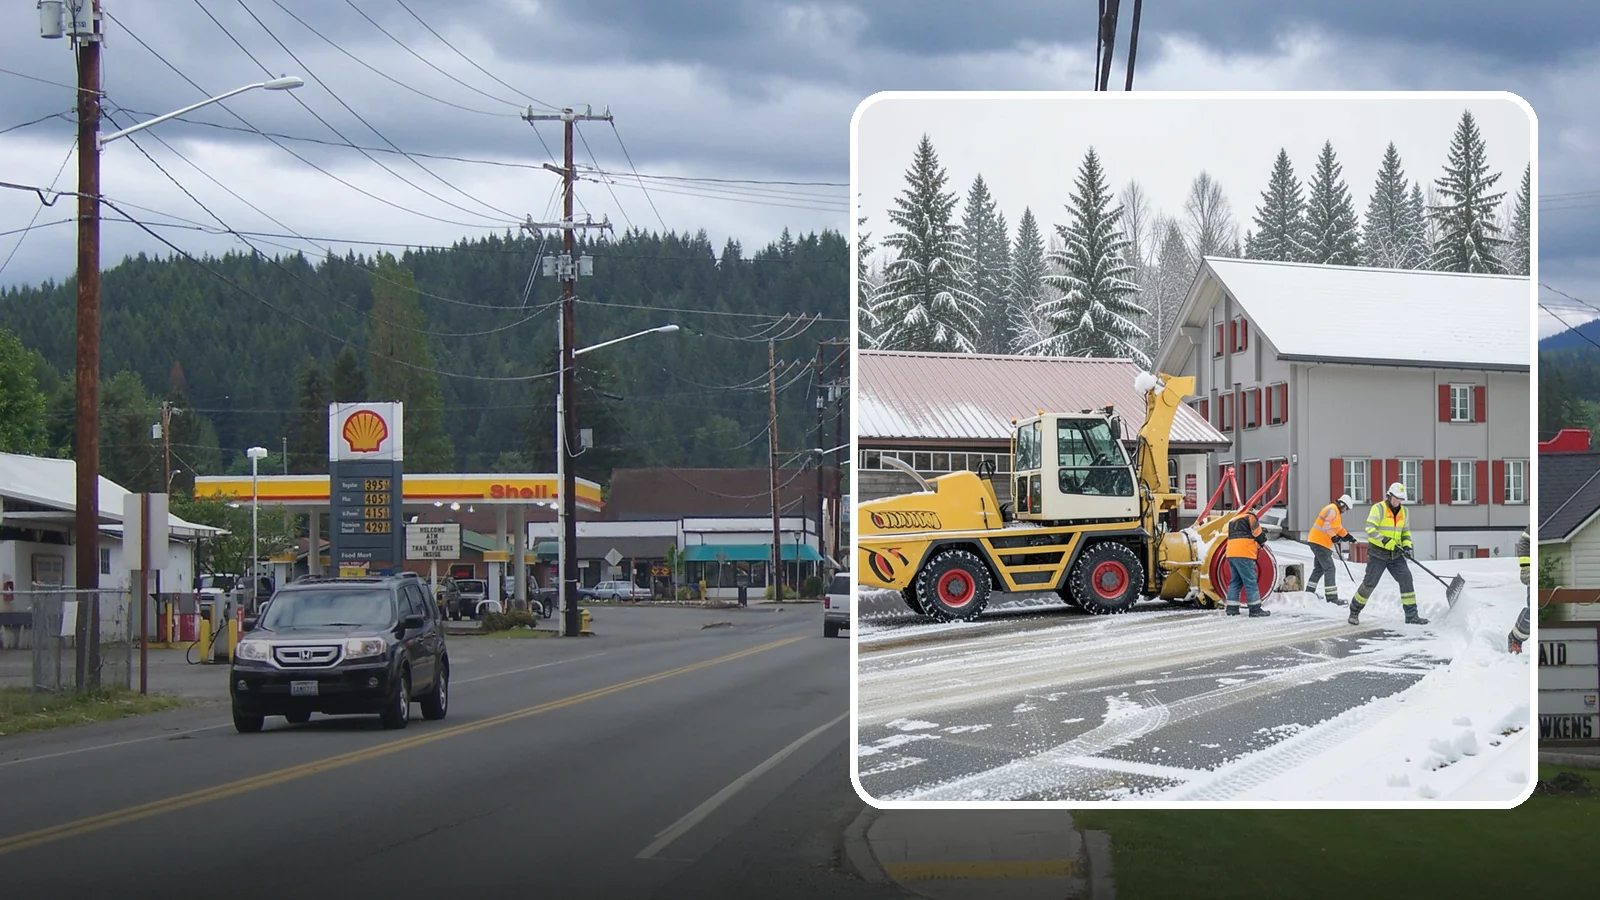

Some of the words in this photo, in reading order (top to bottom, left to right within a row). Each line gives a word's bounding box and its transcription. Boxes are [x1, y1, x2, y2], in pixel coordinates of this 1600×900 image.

[365, 480, 384, 490] 395
[490, 484, 547, 499] Shell
[365, 494, 384, 504] 405
[365, 508, 384, 518] 415
[365, 522, 384, 532] 429
[1538, 642, 1567, 665] AID
